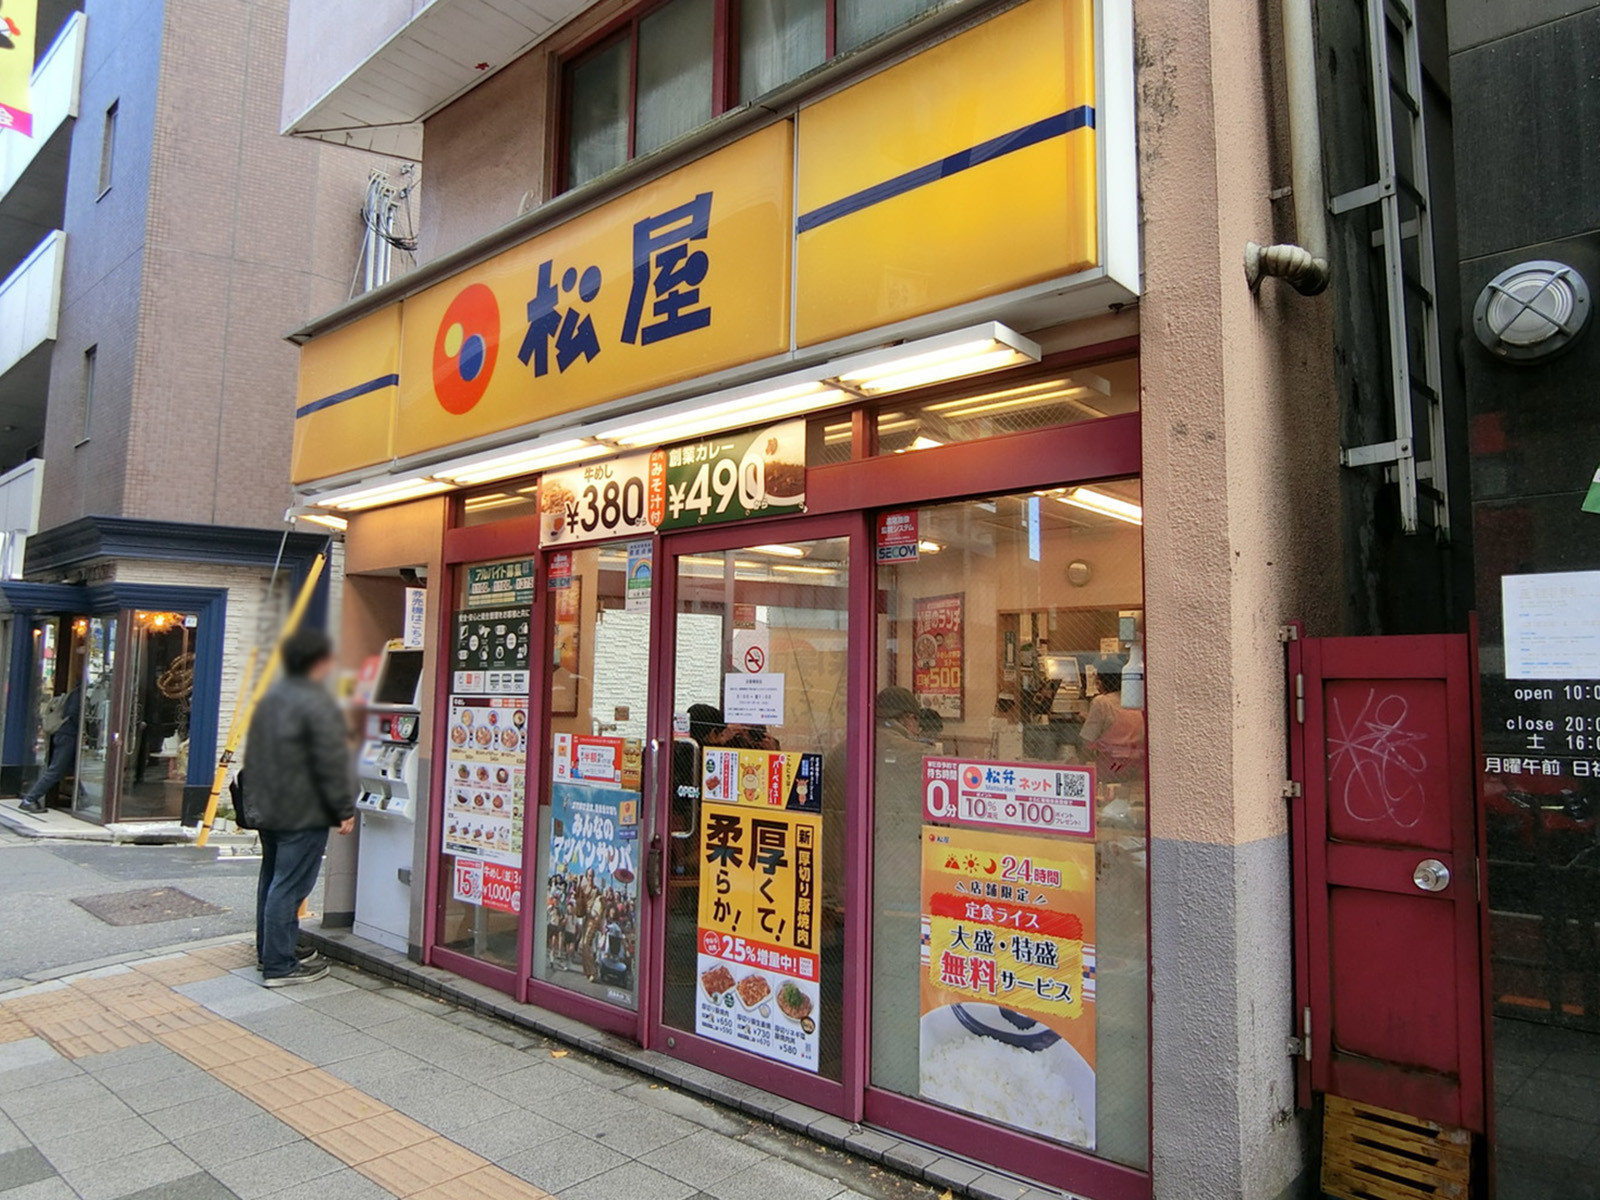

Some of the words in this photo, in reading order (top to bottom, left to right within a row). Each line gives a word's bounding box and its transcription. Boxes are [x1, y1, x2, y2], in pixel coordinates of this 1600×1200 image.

[517, 191, 713, 378] 松屋
[669, 442, 735, 468] 創業カレー
[584, 465, 614, 482] 牛めし
[668, 453, 765, 519] ¥490
[565, 476, 644, 533] ¥380
[879, 545, 917, 560] SECOM
[411, 590, 423, 646] 券売機はこちら
[1514, 688, 1553, 701] open
[1564, 685, 1600, 700] 10:0
[1506, 716, 1554, 730] close
[1526, 733, 1545, 749] 土
[985, 767, 1016, 785] 松弁
[1019, 777, 1052, 792] ネット
[1484, 757, 1560, 776] 月曜午前
[927, 779, 957, 818] 0分
[1018, 802, 1054, 824] 100
[798, 829, 811, 846] 新
[705, 813, 743, 932] 柔らか!
[748, 818, 789, 942] 厚くて!
[1001, 855, 1061, 887] 24時間
[797, 850, 811, 946] 厚切り豚焼肉
[970, 880, 1030, 903] 店舗限定
[965, 901, 1040, 928] 定食ライス
[950, 925, 1058, 968] 大盛・特盛
